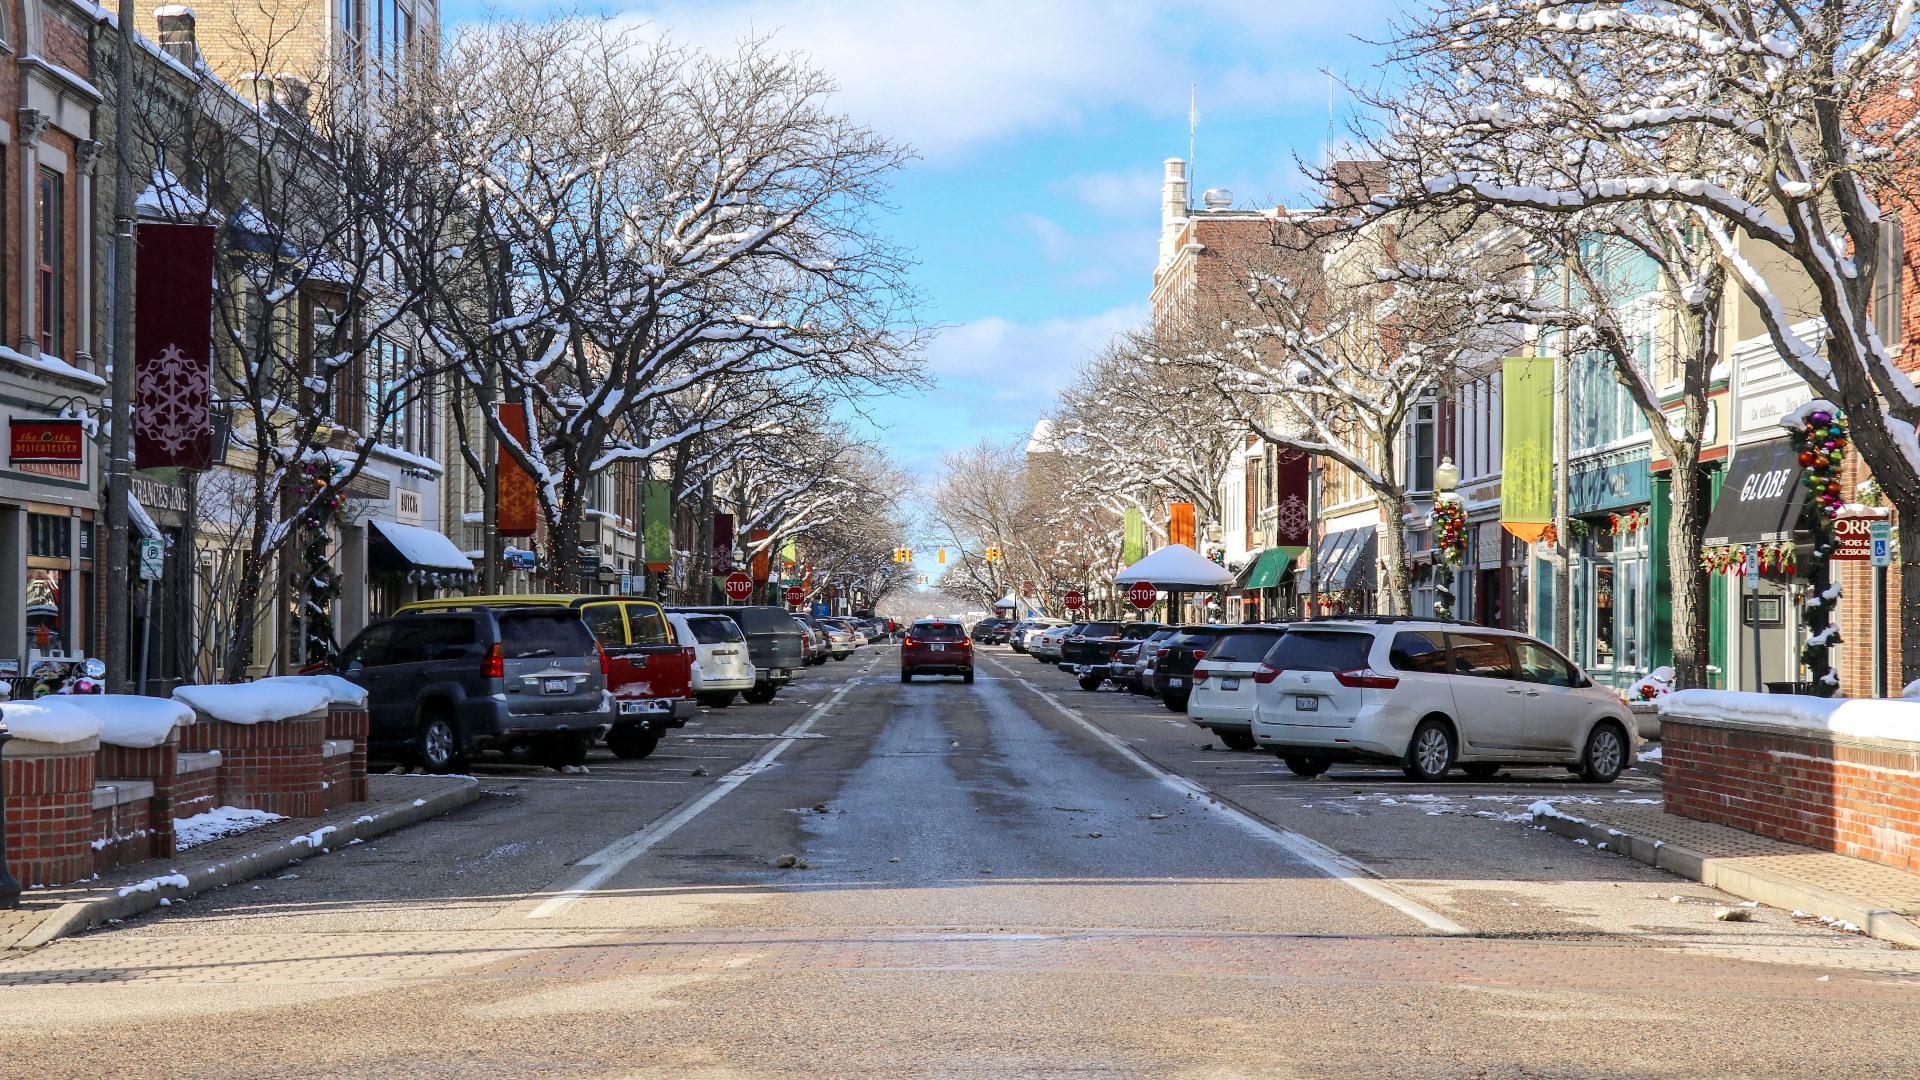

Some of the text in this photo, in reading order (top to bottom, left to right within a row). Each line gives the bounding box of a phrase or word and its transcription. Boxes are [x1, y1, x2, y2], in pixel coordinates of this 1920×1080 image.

[21, 431, 71, 444] the City
[16, 444, 77, 453] DELICATESSEN
[1740, 468, 1791, 502] GLOBE
[131, 478, 168, 509] FRANCES
[1833, 519, 1872, 535] ORR
[1834, 548, 1871, 556] CCESSORI
[726, 581, 752, 592] STOP
[787, 592, 804, 600] STOP
[1065, 596, 1082, 604] STOP
[1131, 589, 1156, 600] STOP
